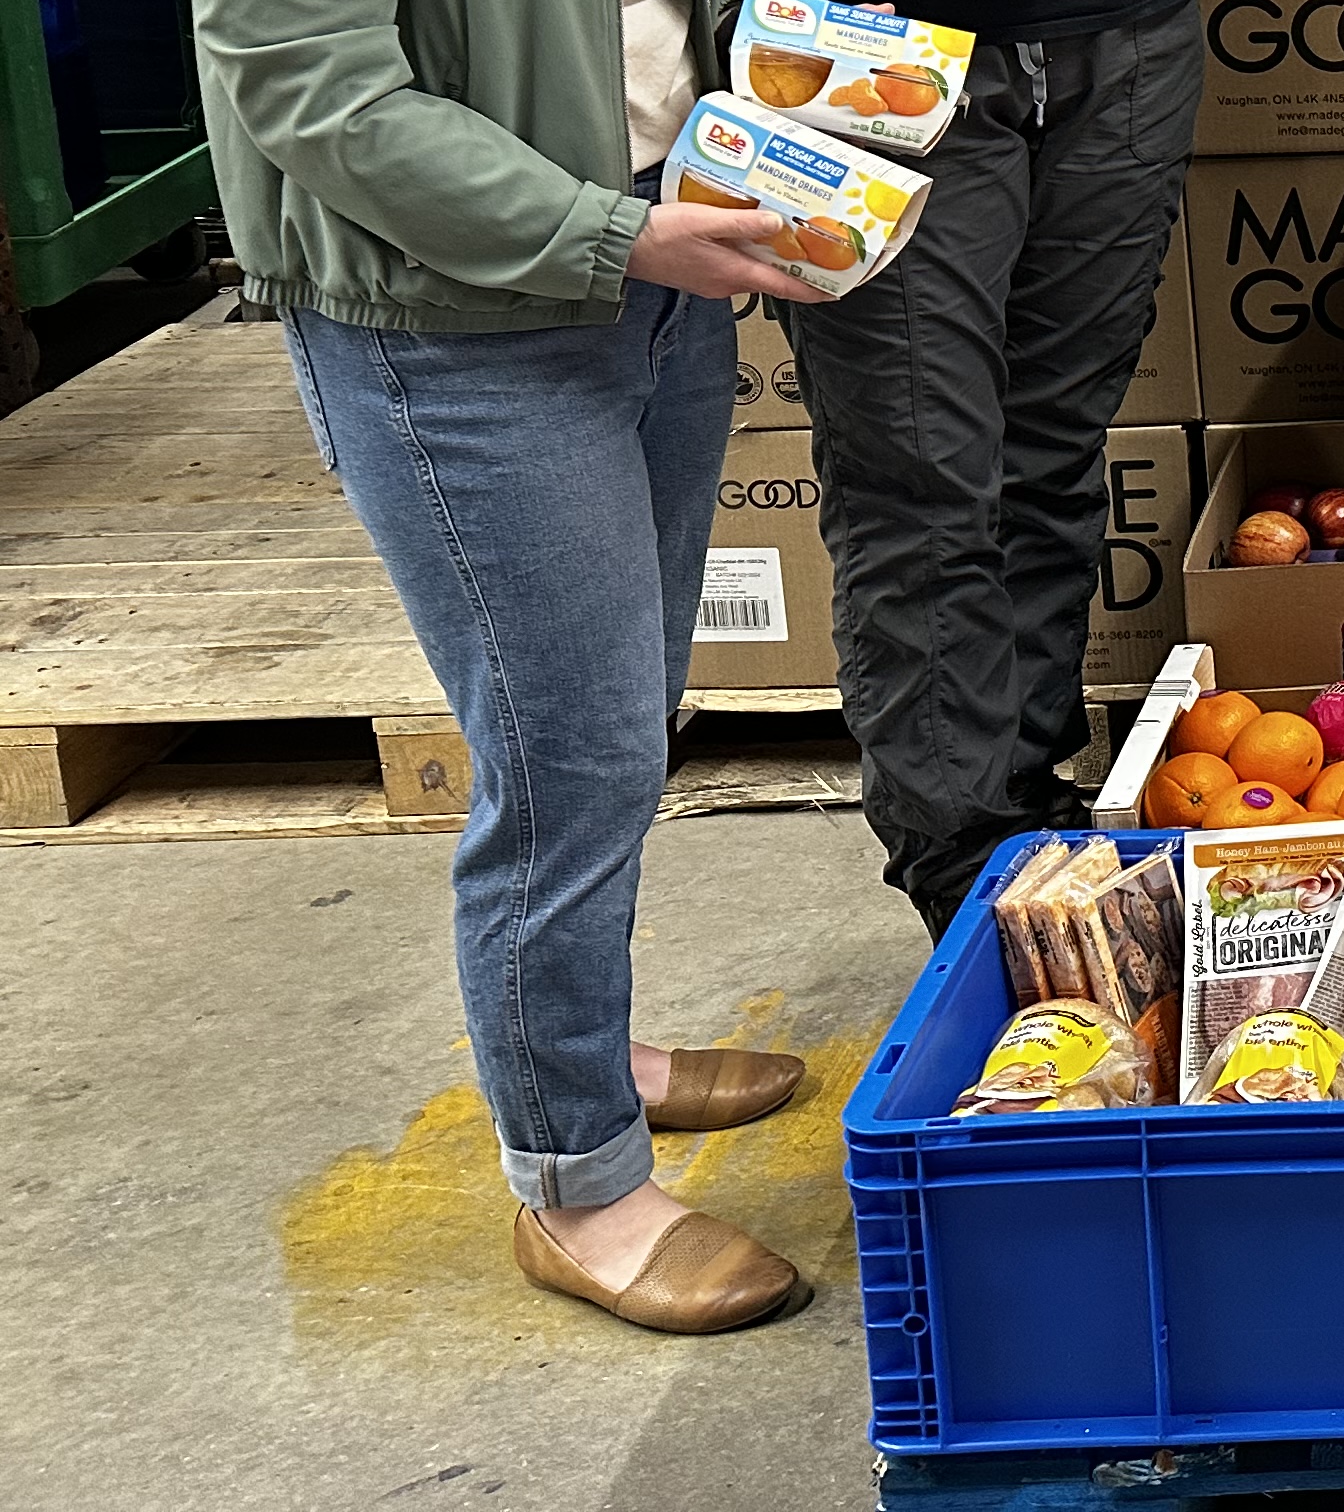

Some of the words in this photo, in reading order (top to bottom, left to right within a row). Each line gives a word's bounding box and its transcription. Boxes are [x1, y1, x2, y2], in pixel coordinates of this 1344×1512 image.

[766, 1, 806, 22] Dole
[1216, 94, 1270, 108] Vaughan,
[1273, 95, 1291, 106] ON
[1296, 94, 1319, 105] L4K
[708, 123, 747, 150] Dole
[771, 138, 785, 150] NO
[785, 143, 816, 165] SUGAR
[815, 157, 845, 178] ADDED
[1240, 364, 1293, 376] Vaughan,
[1216, 847, 1250, 859] Honey
[1327, 841, 1340, 849] au
